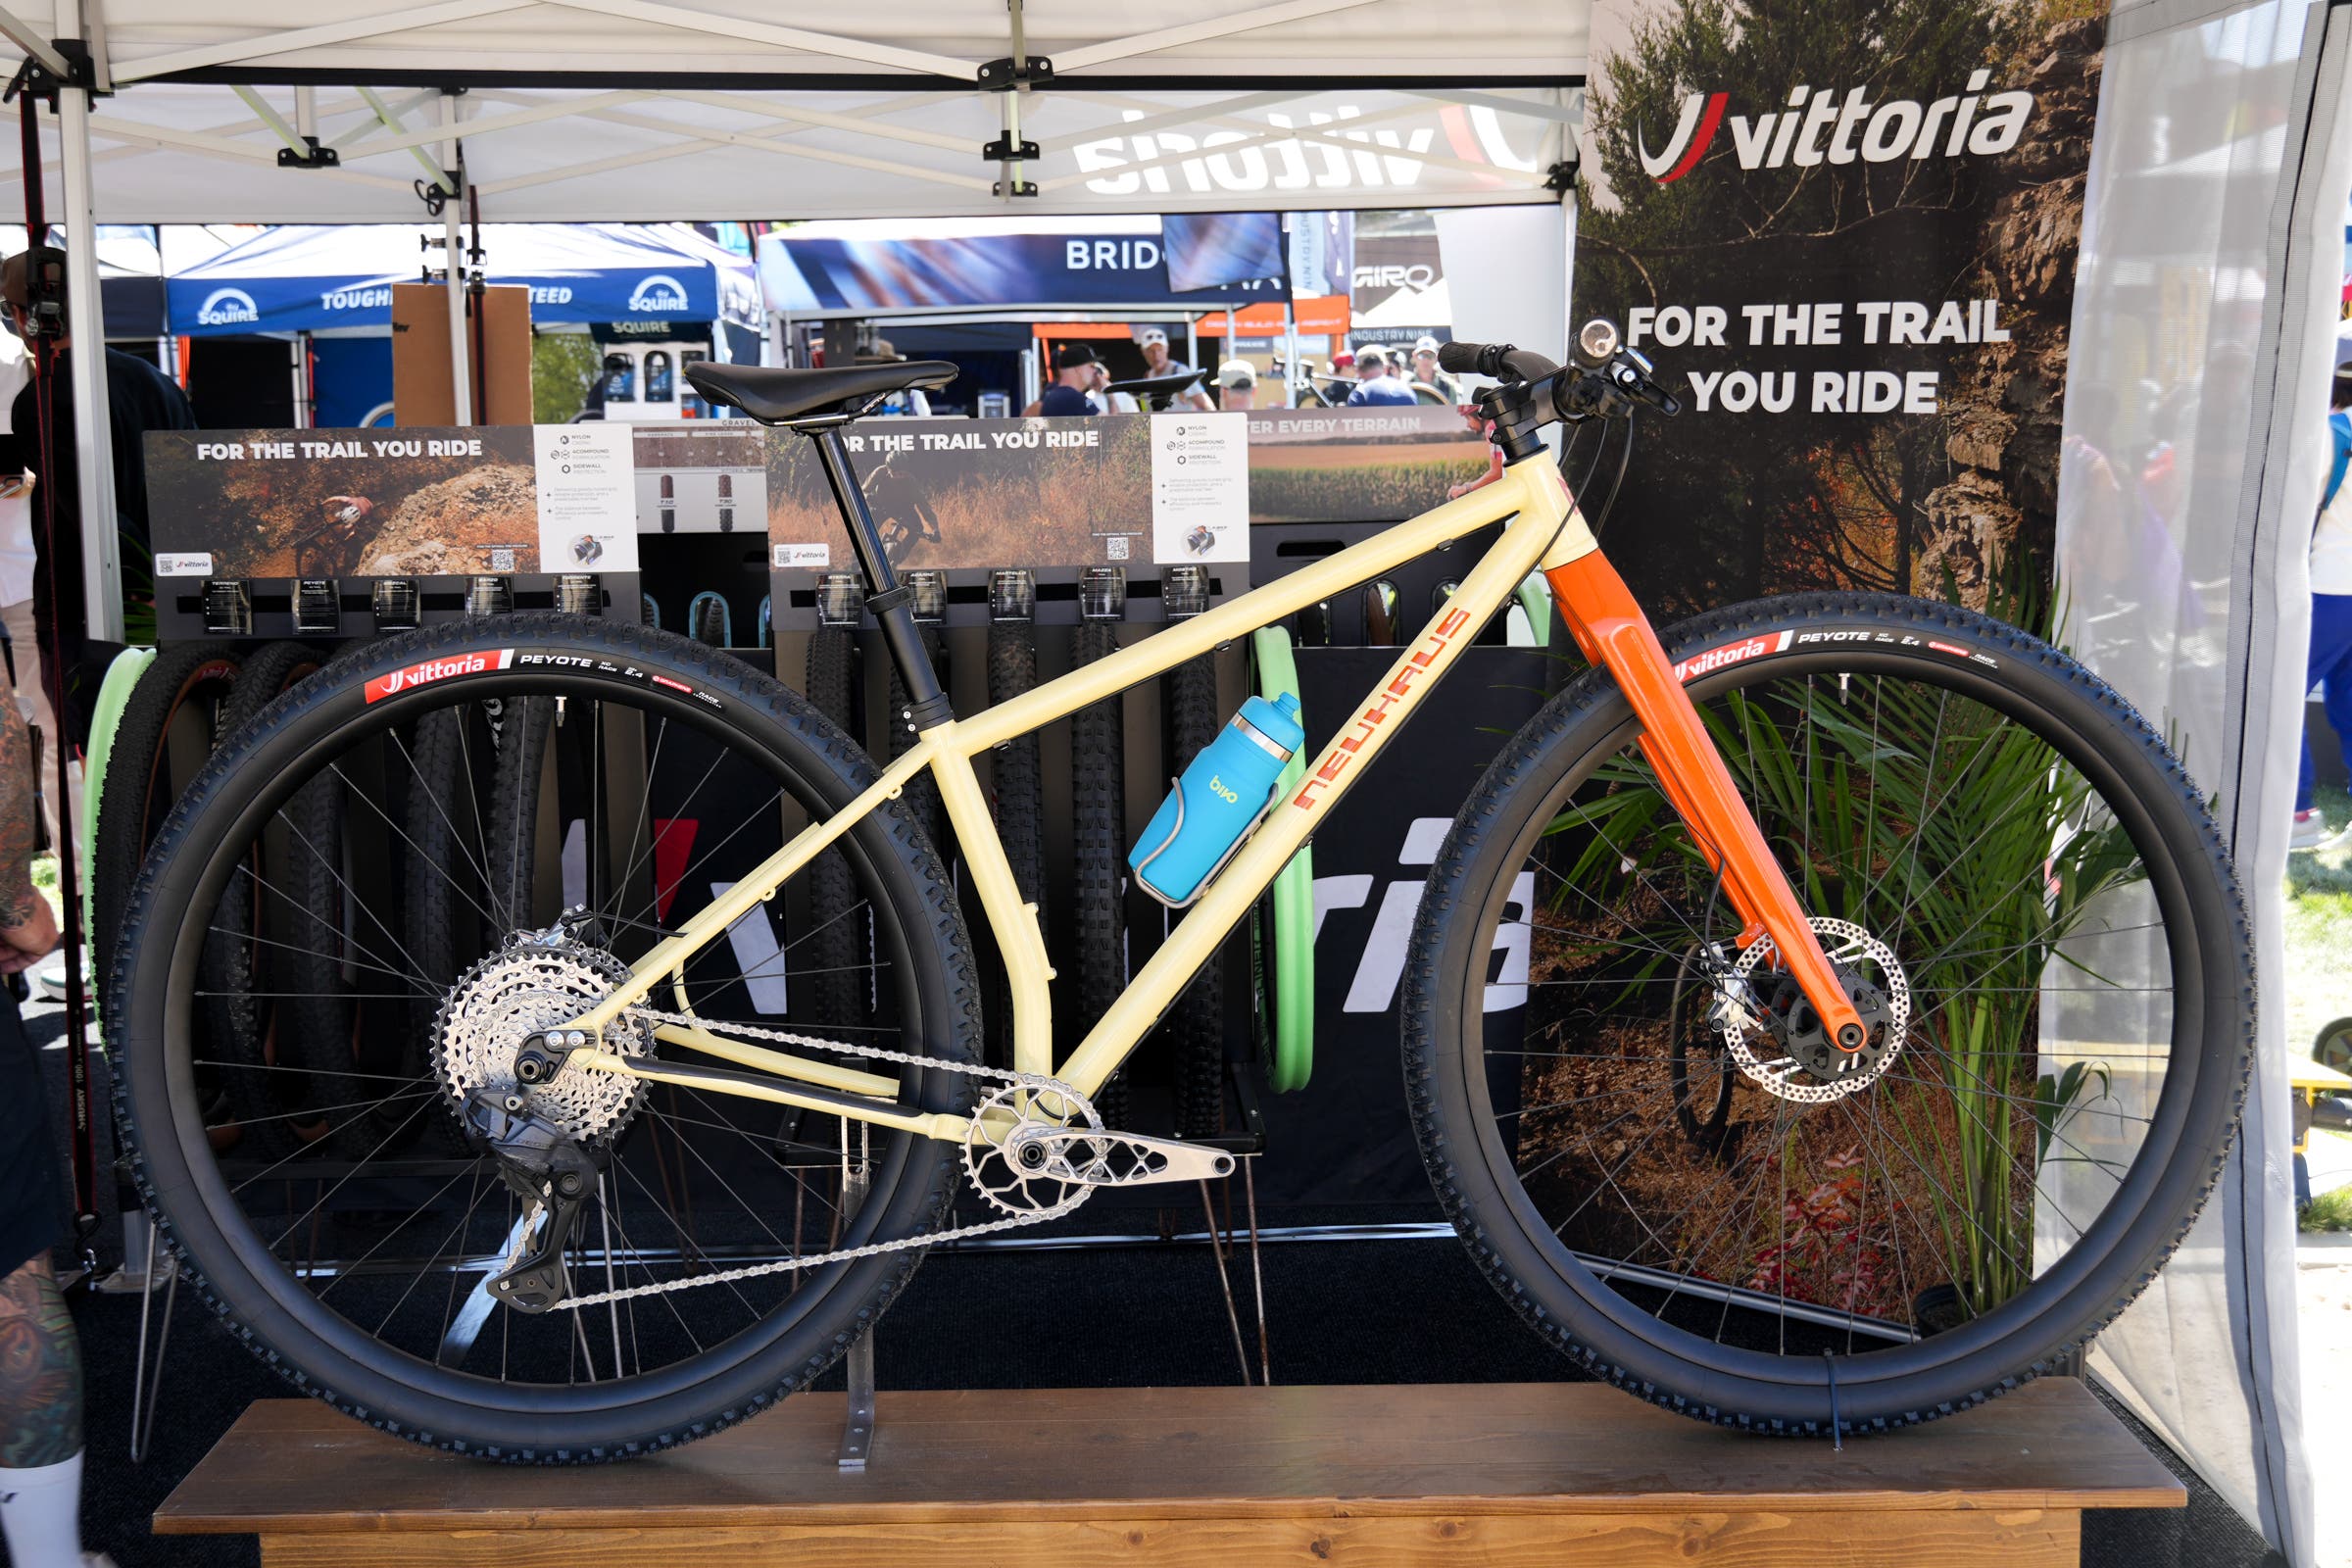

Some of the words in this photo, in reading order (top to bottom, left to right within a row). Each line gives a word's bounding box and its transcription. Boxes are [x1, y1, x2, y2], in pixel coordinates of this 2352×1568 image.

[1730, 69, 2035, 170] vittoria
[1066, 240, 1167, 270] BRID
[1351, 265, 1434, 292] GIRO
[320, 290, 393, 311] TOUGH
[628, 296, 689, 313] SQUIRE
[197, 310, 259, 325] SQUIRE
[612, 321, 671, 334] SQUIRE
[1627, 305, 1728, 347] FOR
[1741, 303, 1843, 346] THE
[1856, 299, 2011, 345] TRAIL
[1351, 328, 1404, 341] INDUSTRY
[1686, 370, 1796, 415] YOU
[1810, 370, 1939, 415] RIDE
[1278, 418, 1337, 433] EVERY
[1342, 416, 1421, 432] TERRAIN
[197, 443, 244, 461] FOR
[249, 442, 295, 460] THE
[300, 441, 368, 459] TRAIL
[371, 440, 422, 458] YOU
[428, 439, 482, 457] RIDE
[870, 434, 914, 452] THE
[920, 432, 986, 451] TRAIL
[991, 431, 1041, 449] YOU
[1046, 430, 1100, 448] RIDE
[1688, 639, 1765, 675] vittoria
[1797, 631, 1871, 643] PEYOTE
[406, 655, 485, 686] vittoria
[520, 654, 593, 668] PEYOTE
